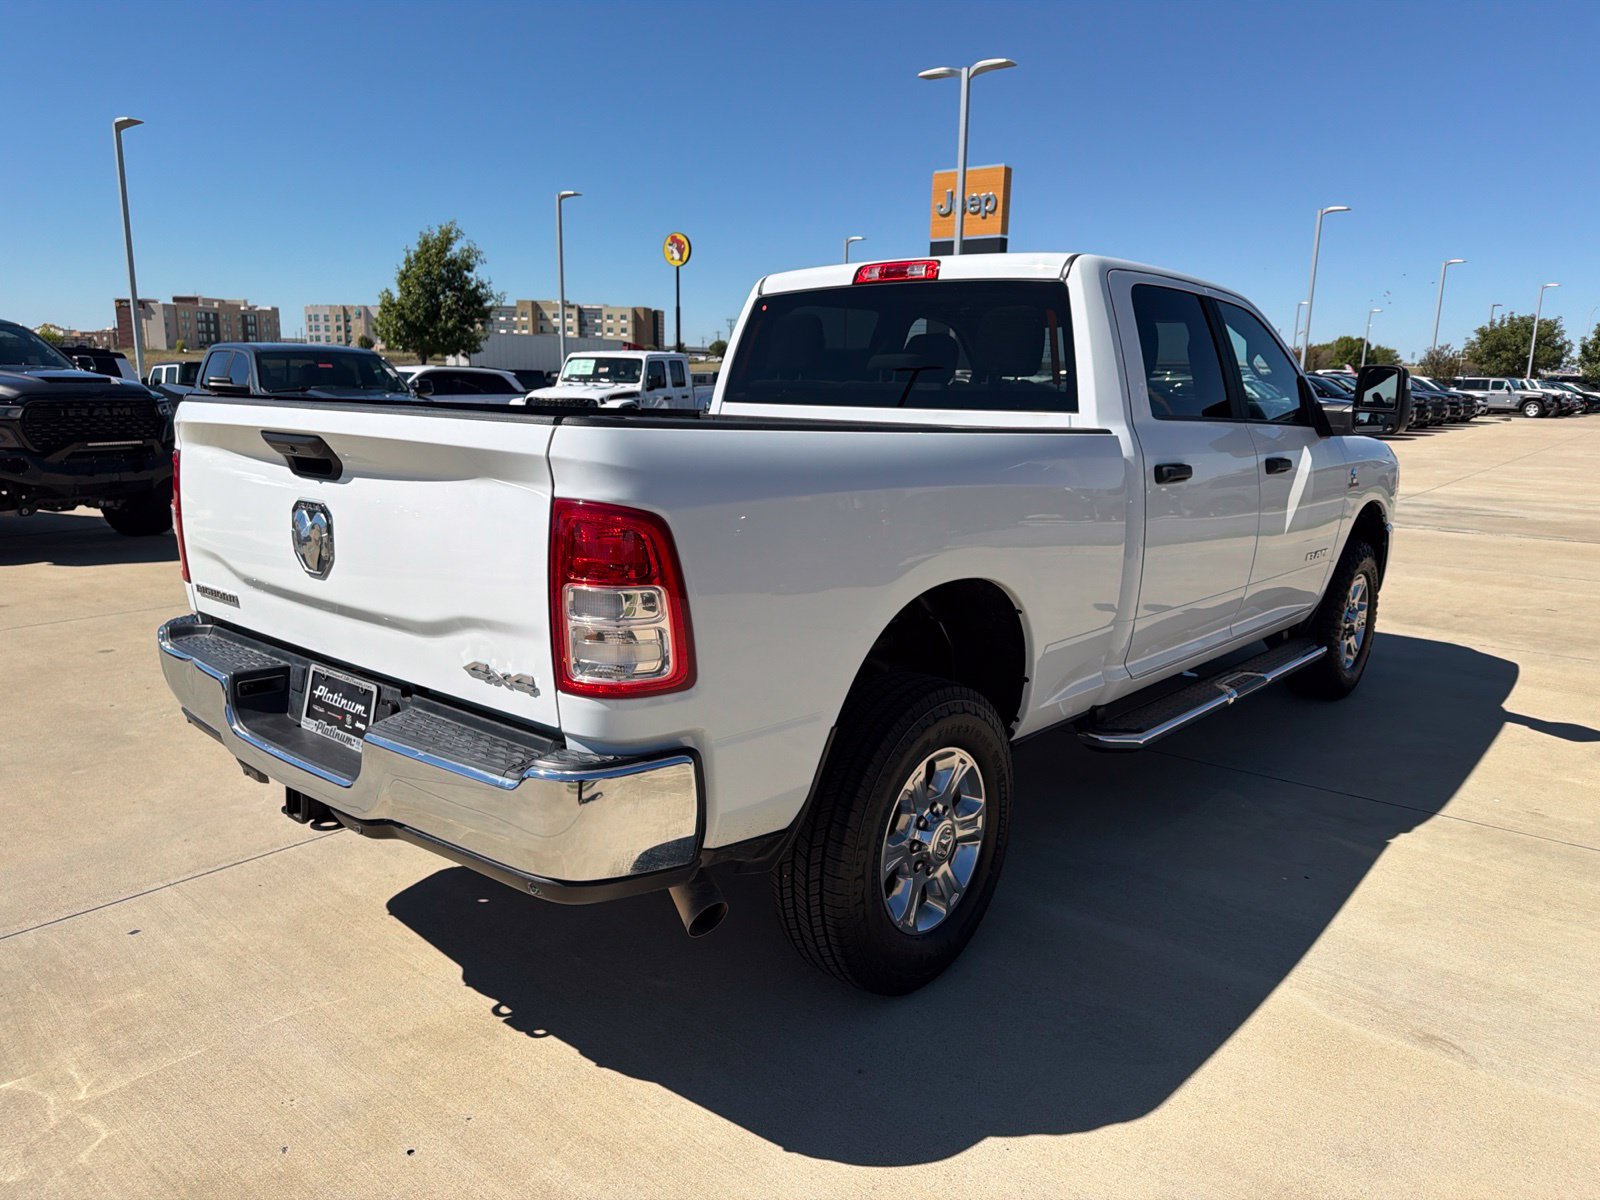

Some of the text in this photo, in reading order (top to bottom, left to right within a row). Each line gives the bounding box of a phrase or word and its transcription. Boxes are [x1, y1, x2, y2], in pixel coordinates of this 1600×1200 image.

[67, 407, 131, 417] RAM
[313, 685, 367, 717] Platinum
[316, 721, 355, 747] Platinum
